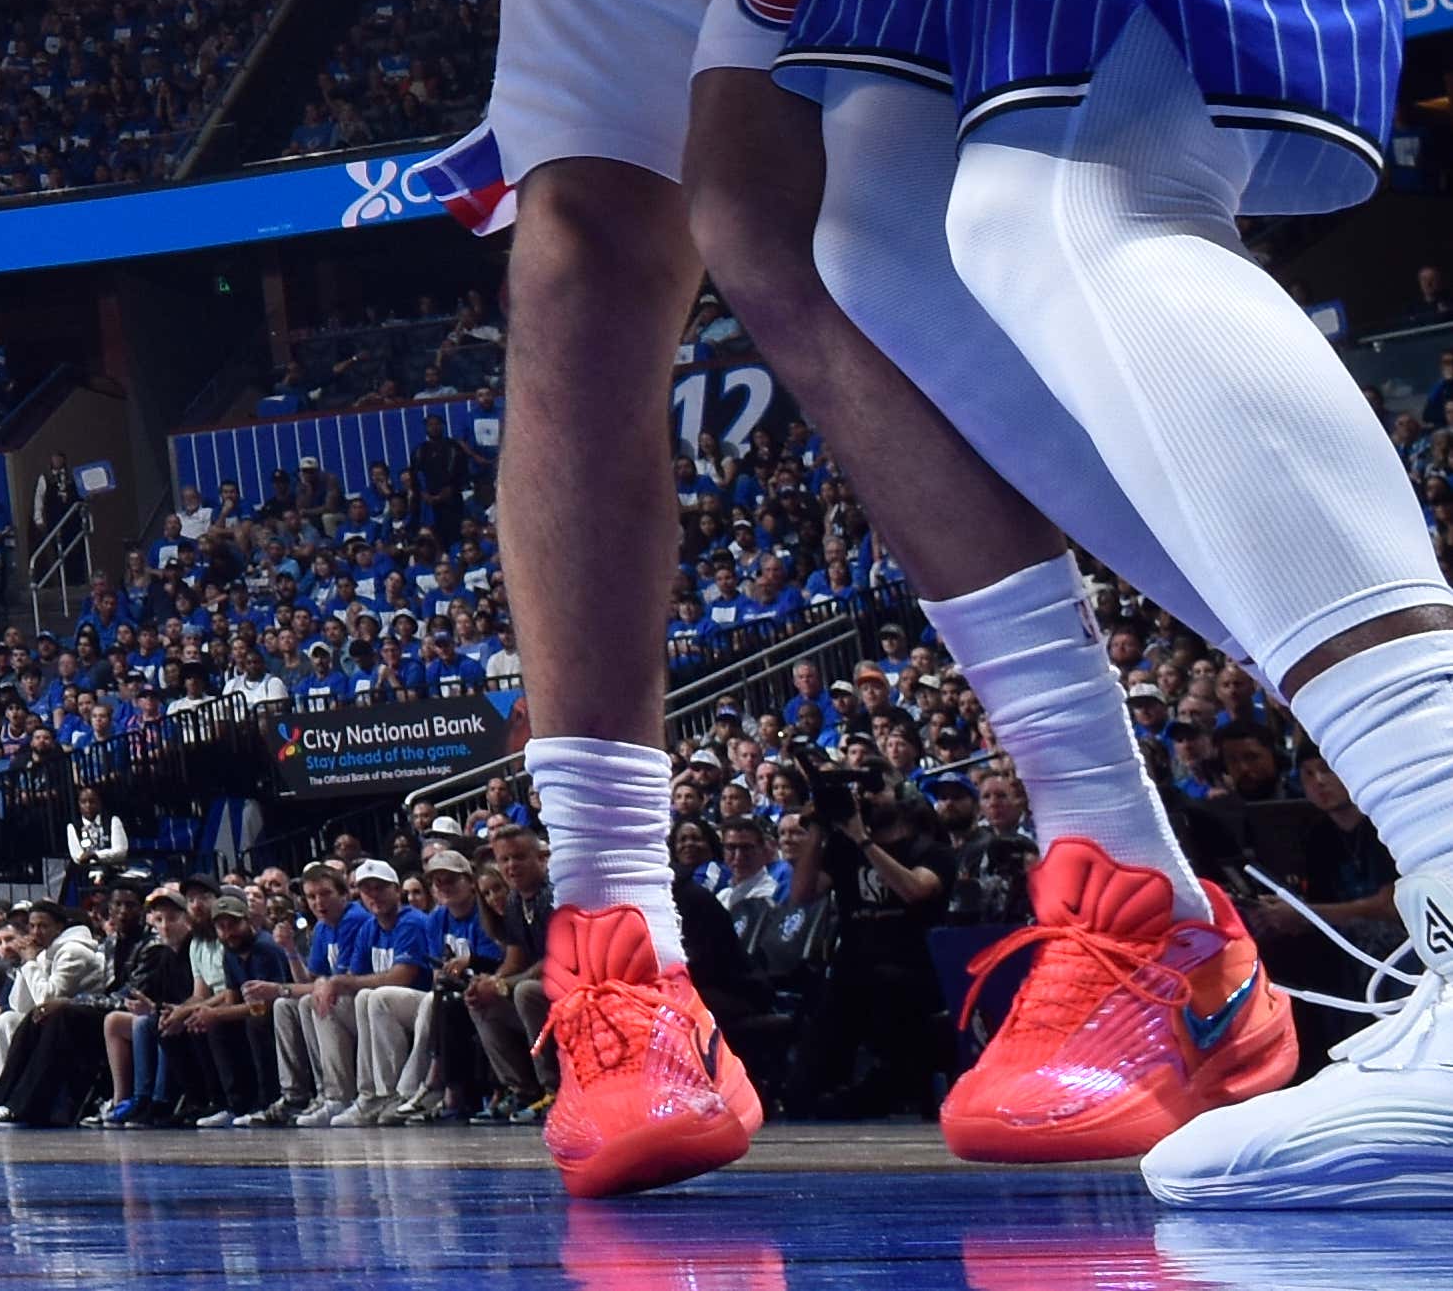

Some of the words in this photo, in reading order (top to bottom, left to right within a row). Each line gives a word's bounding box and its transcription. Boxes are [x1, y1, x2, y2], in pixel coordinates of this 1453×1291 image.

[303, 728, 340, 753] City
[347, 721, 429, 747] National
[434, 714, 485, 736] Bank
[306, 754, 336, 771] Stay
[339, 751, 381, 767] ahead
[385, 749, 399, 764] of
[401, 746, 424, 762] the
[427, 743, 471, 762] game.
[309, 776, 322, 786] The
[324, 774, 350, 785] Official
[352, 772, 370, 783] Bank
[381, 770, 393, 780] the
[394, 767, 426, 778] Orlando
